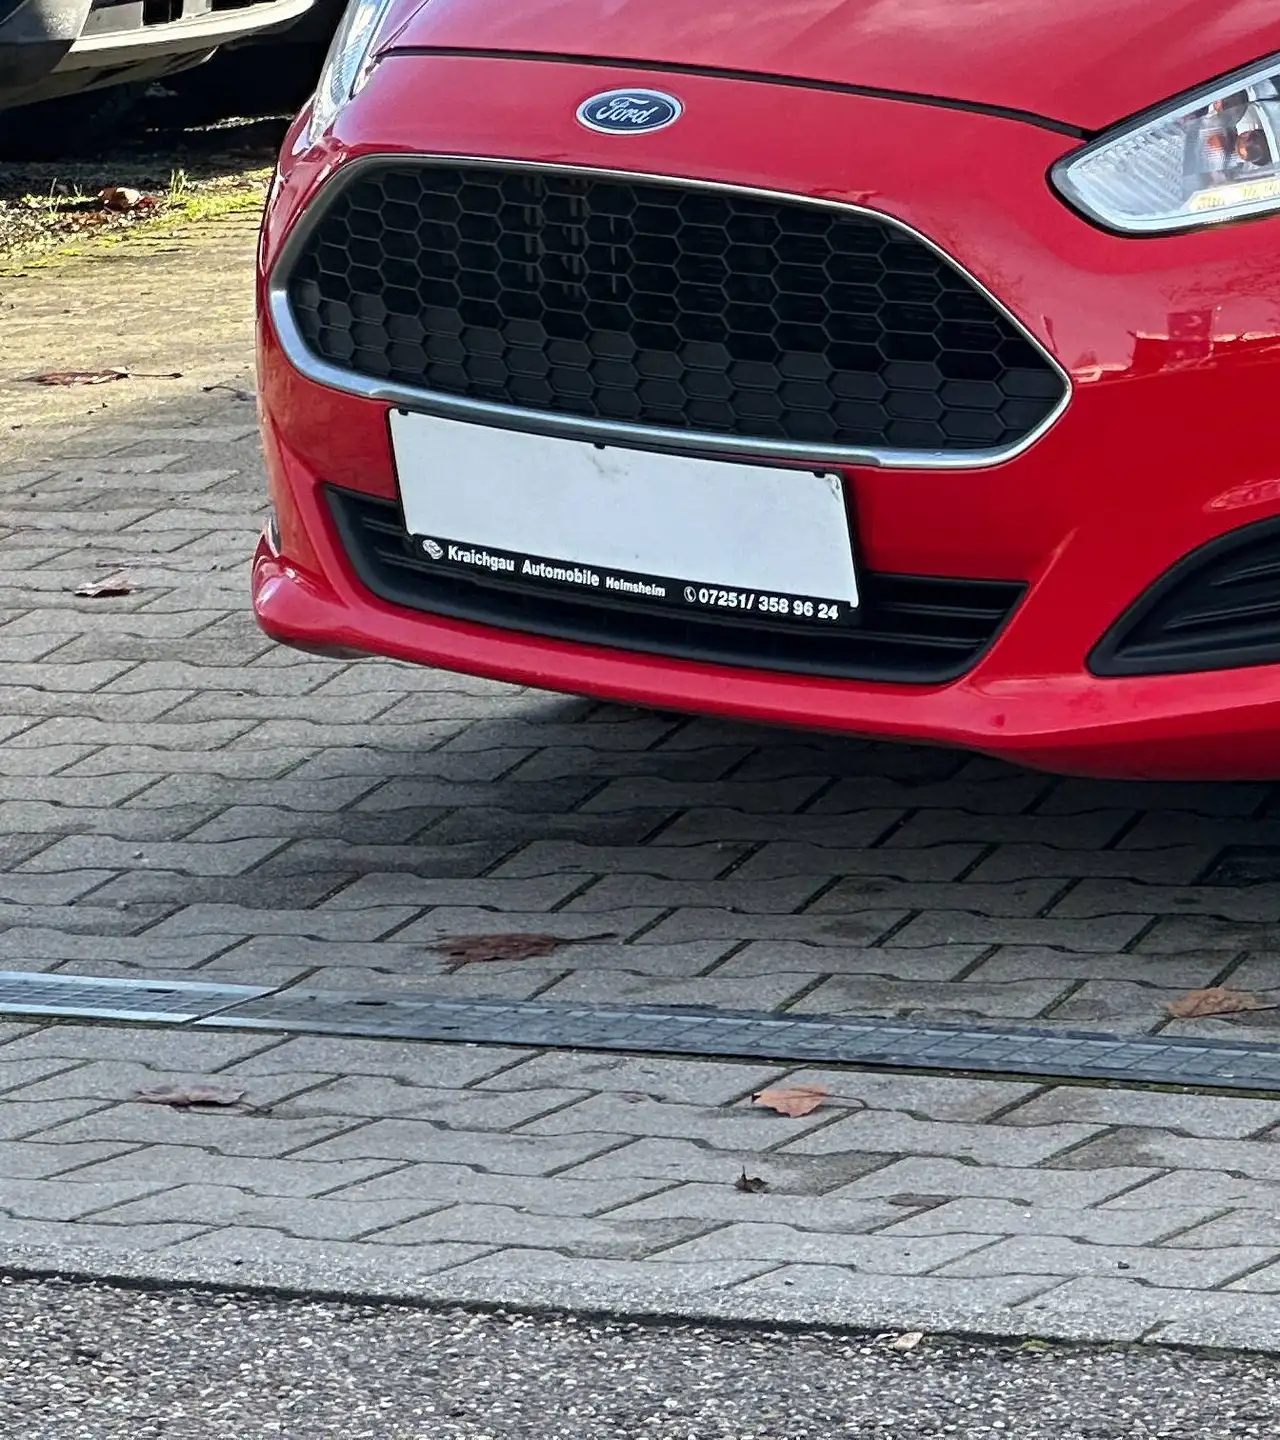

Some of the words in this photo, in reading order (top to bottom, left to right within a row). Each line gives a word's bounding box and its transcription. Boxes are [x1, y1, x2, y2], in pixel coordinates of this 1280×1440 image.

[595, 96, 659, 124] Ford
[448, 545, 515, 572] Kraichgau
[522, 560, 600, 587] Automobile
[698, 588, 755, 610] 07251/
[758, 596, 789, 614] 358
[793, 600, 814, 616] 96
[817, 603, 839, 620] 24
